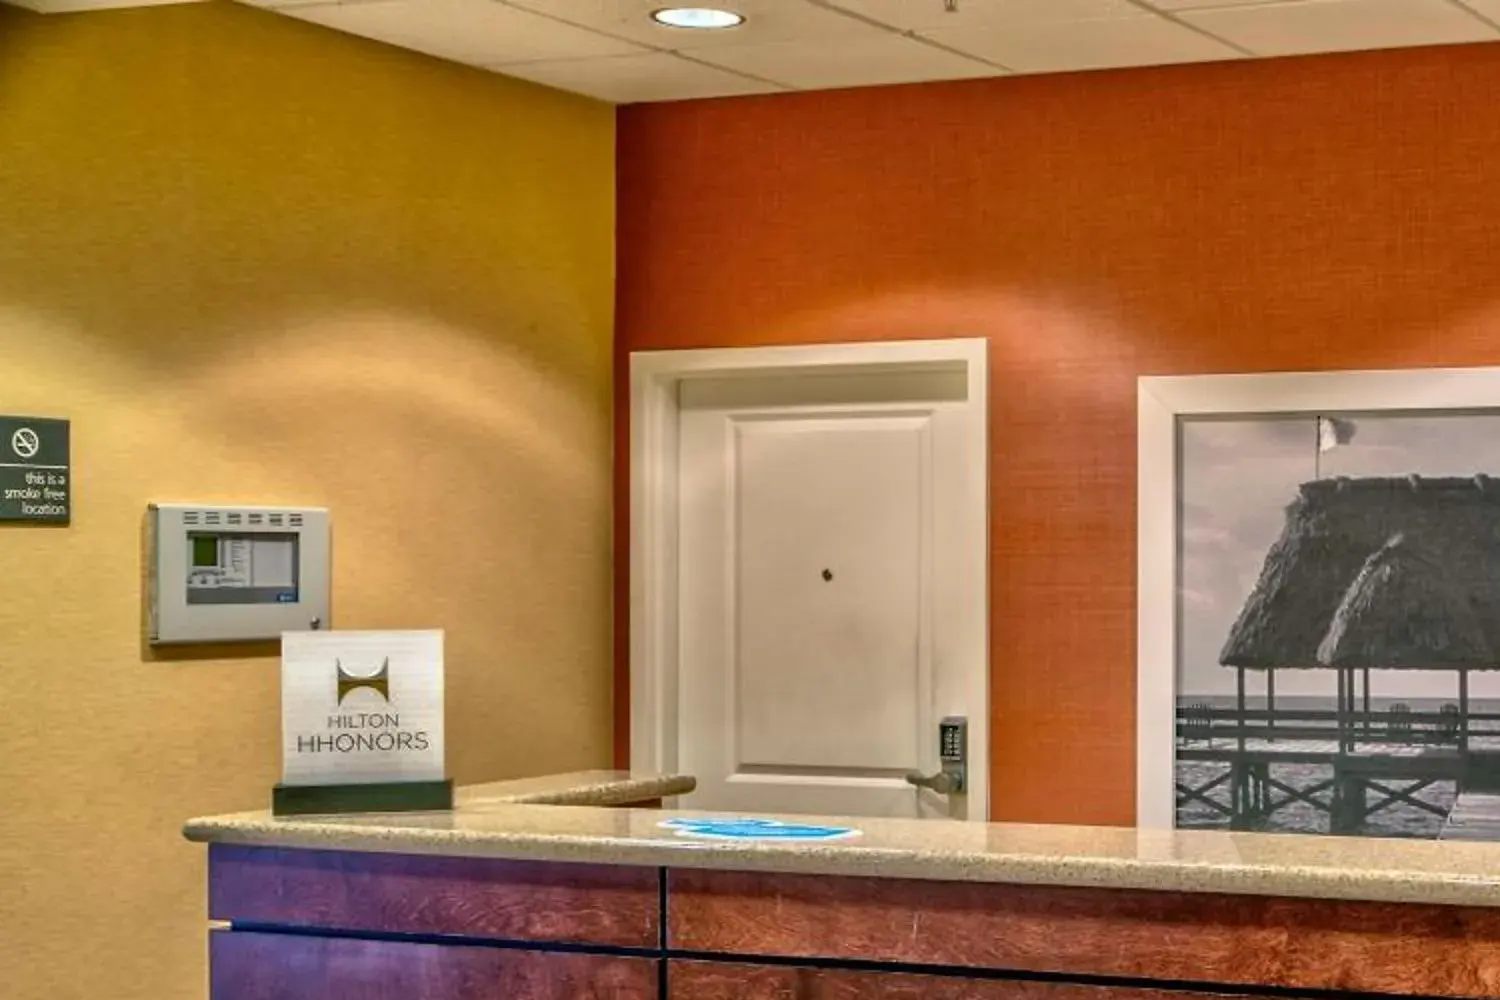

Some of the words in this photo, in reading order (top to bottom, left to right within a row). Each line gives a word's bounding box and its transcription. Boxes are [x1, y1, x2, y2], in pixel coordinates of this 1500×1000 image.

[25, 472, 46, 484] this
[47, 472, 57, 484] is
[58, 475, 66, 485] a
[5, 488, 41, 499] smoke
[43, 487, 66, 500] free
[21, 502, 67, 515] location
[327, 713, 399, 729] HILTON
[297, 731, 429, 753] HHONORS
